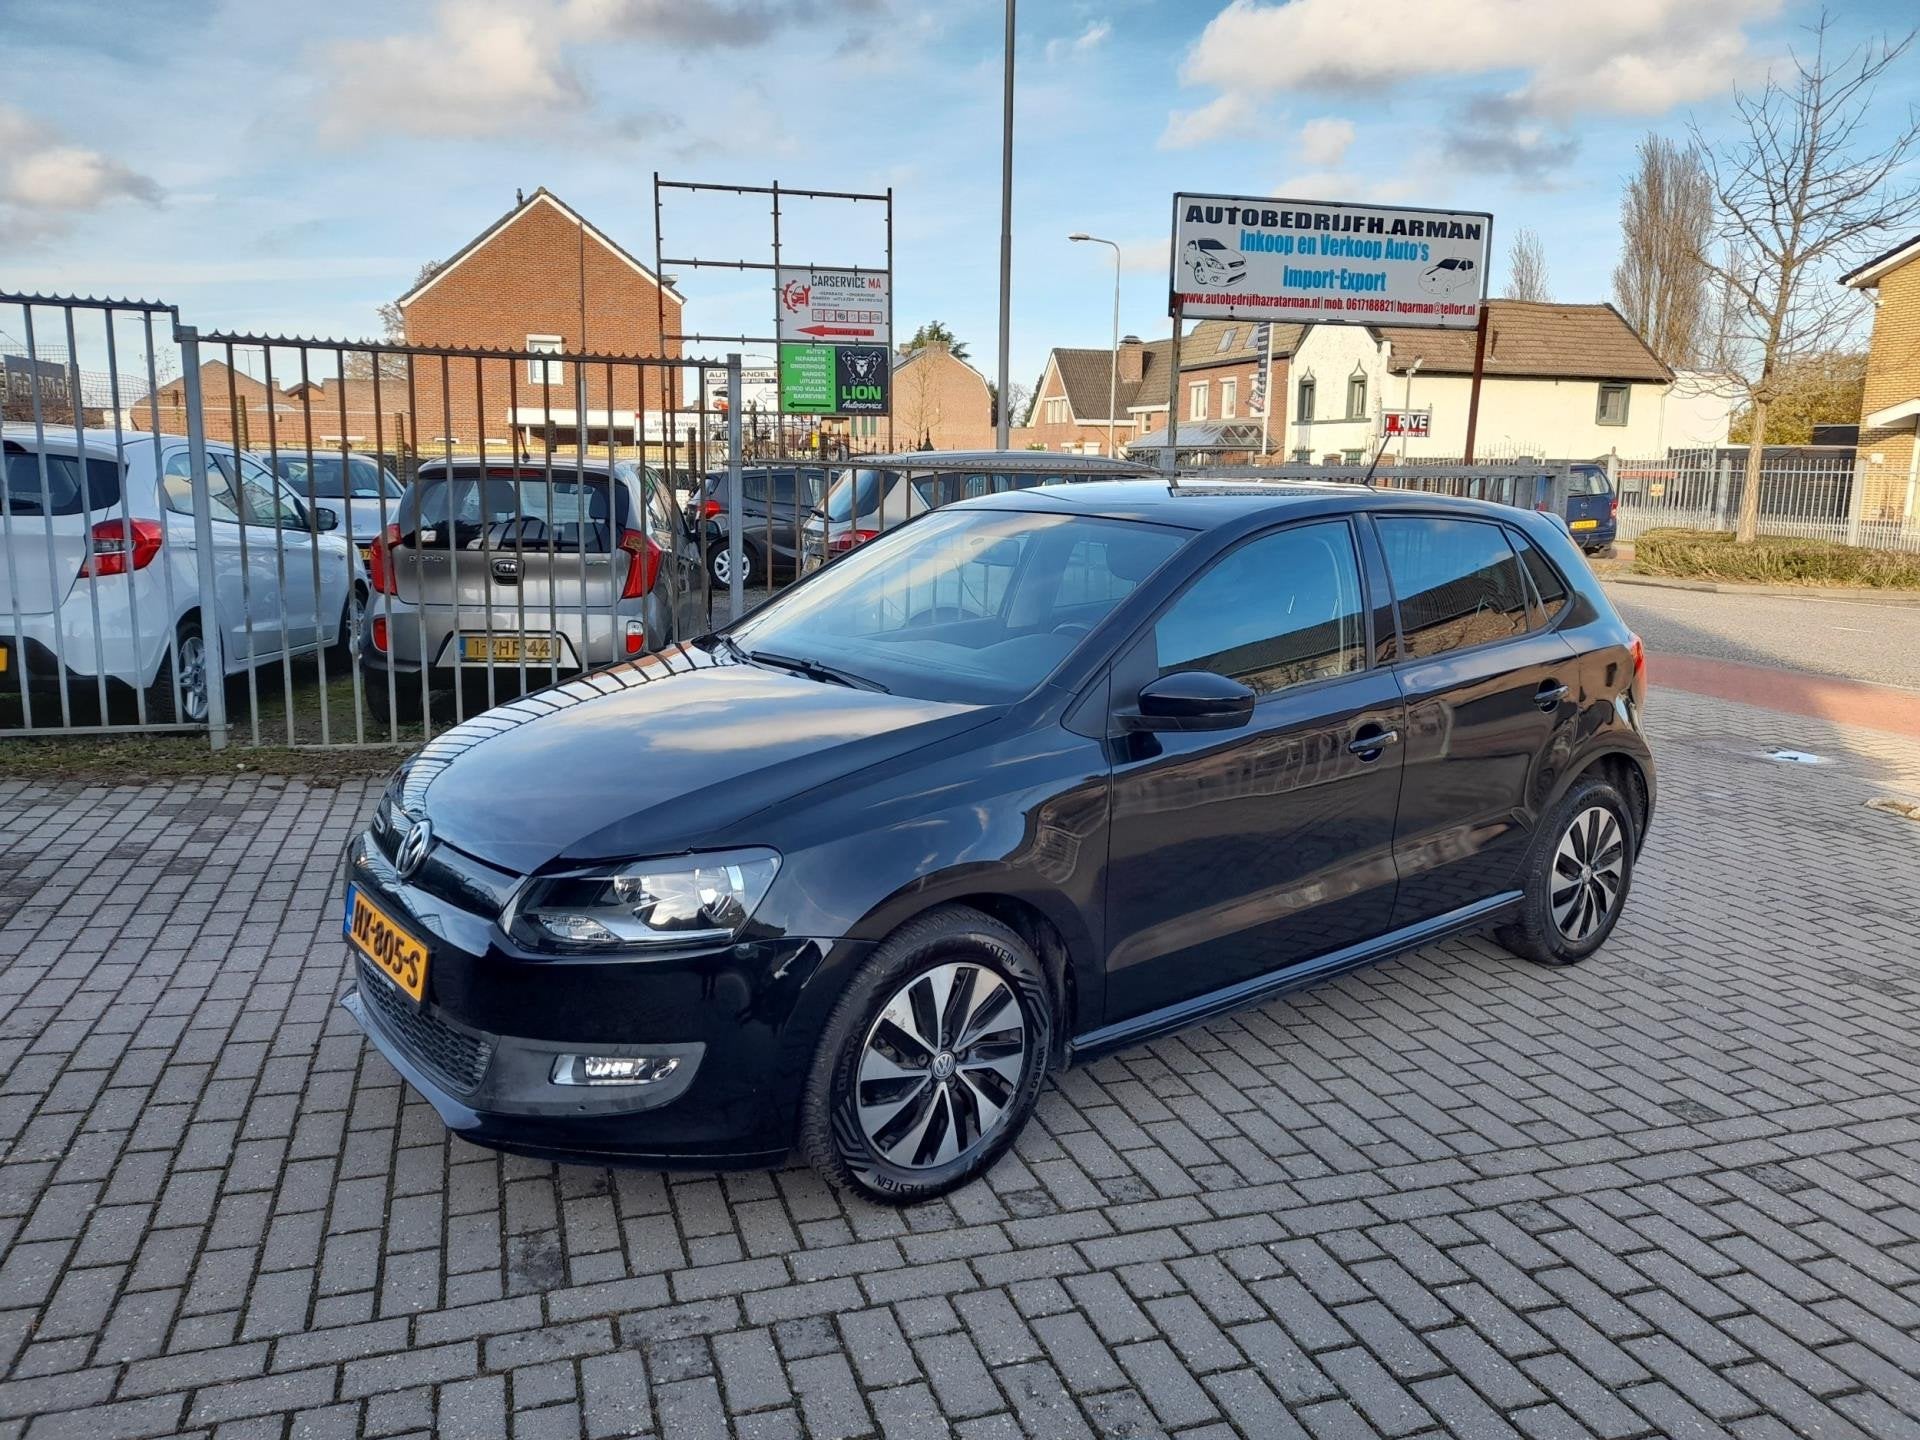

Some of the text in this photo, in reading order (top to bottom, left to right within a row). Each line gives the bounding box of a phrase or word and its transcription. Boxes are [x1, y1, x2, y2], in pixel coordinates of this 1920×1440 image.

[1240, 229, 1430, 262] Inkoop en Verkoop Auto's
[811, 274, 882, 289] CARSERVICE MA
[1282, 265, 1387, 293] Import-Export
[841, 385, 882, 400] LION
